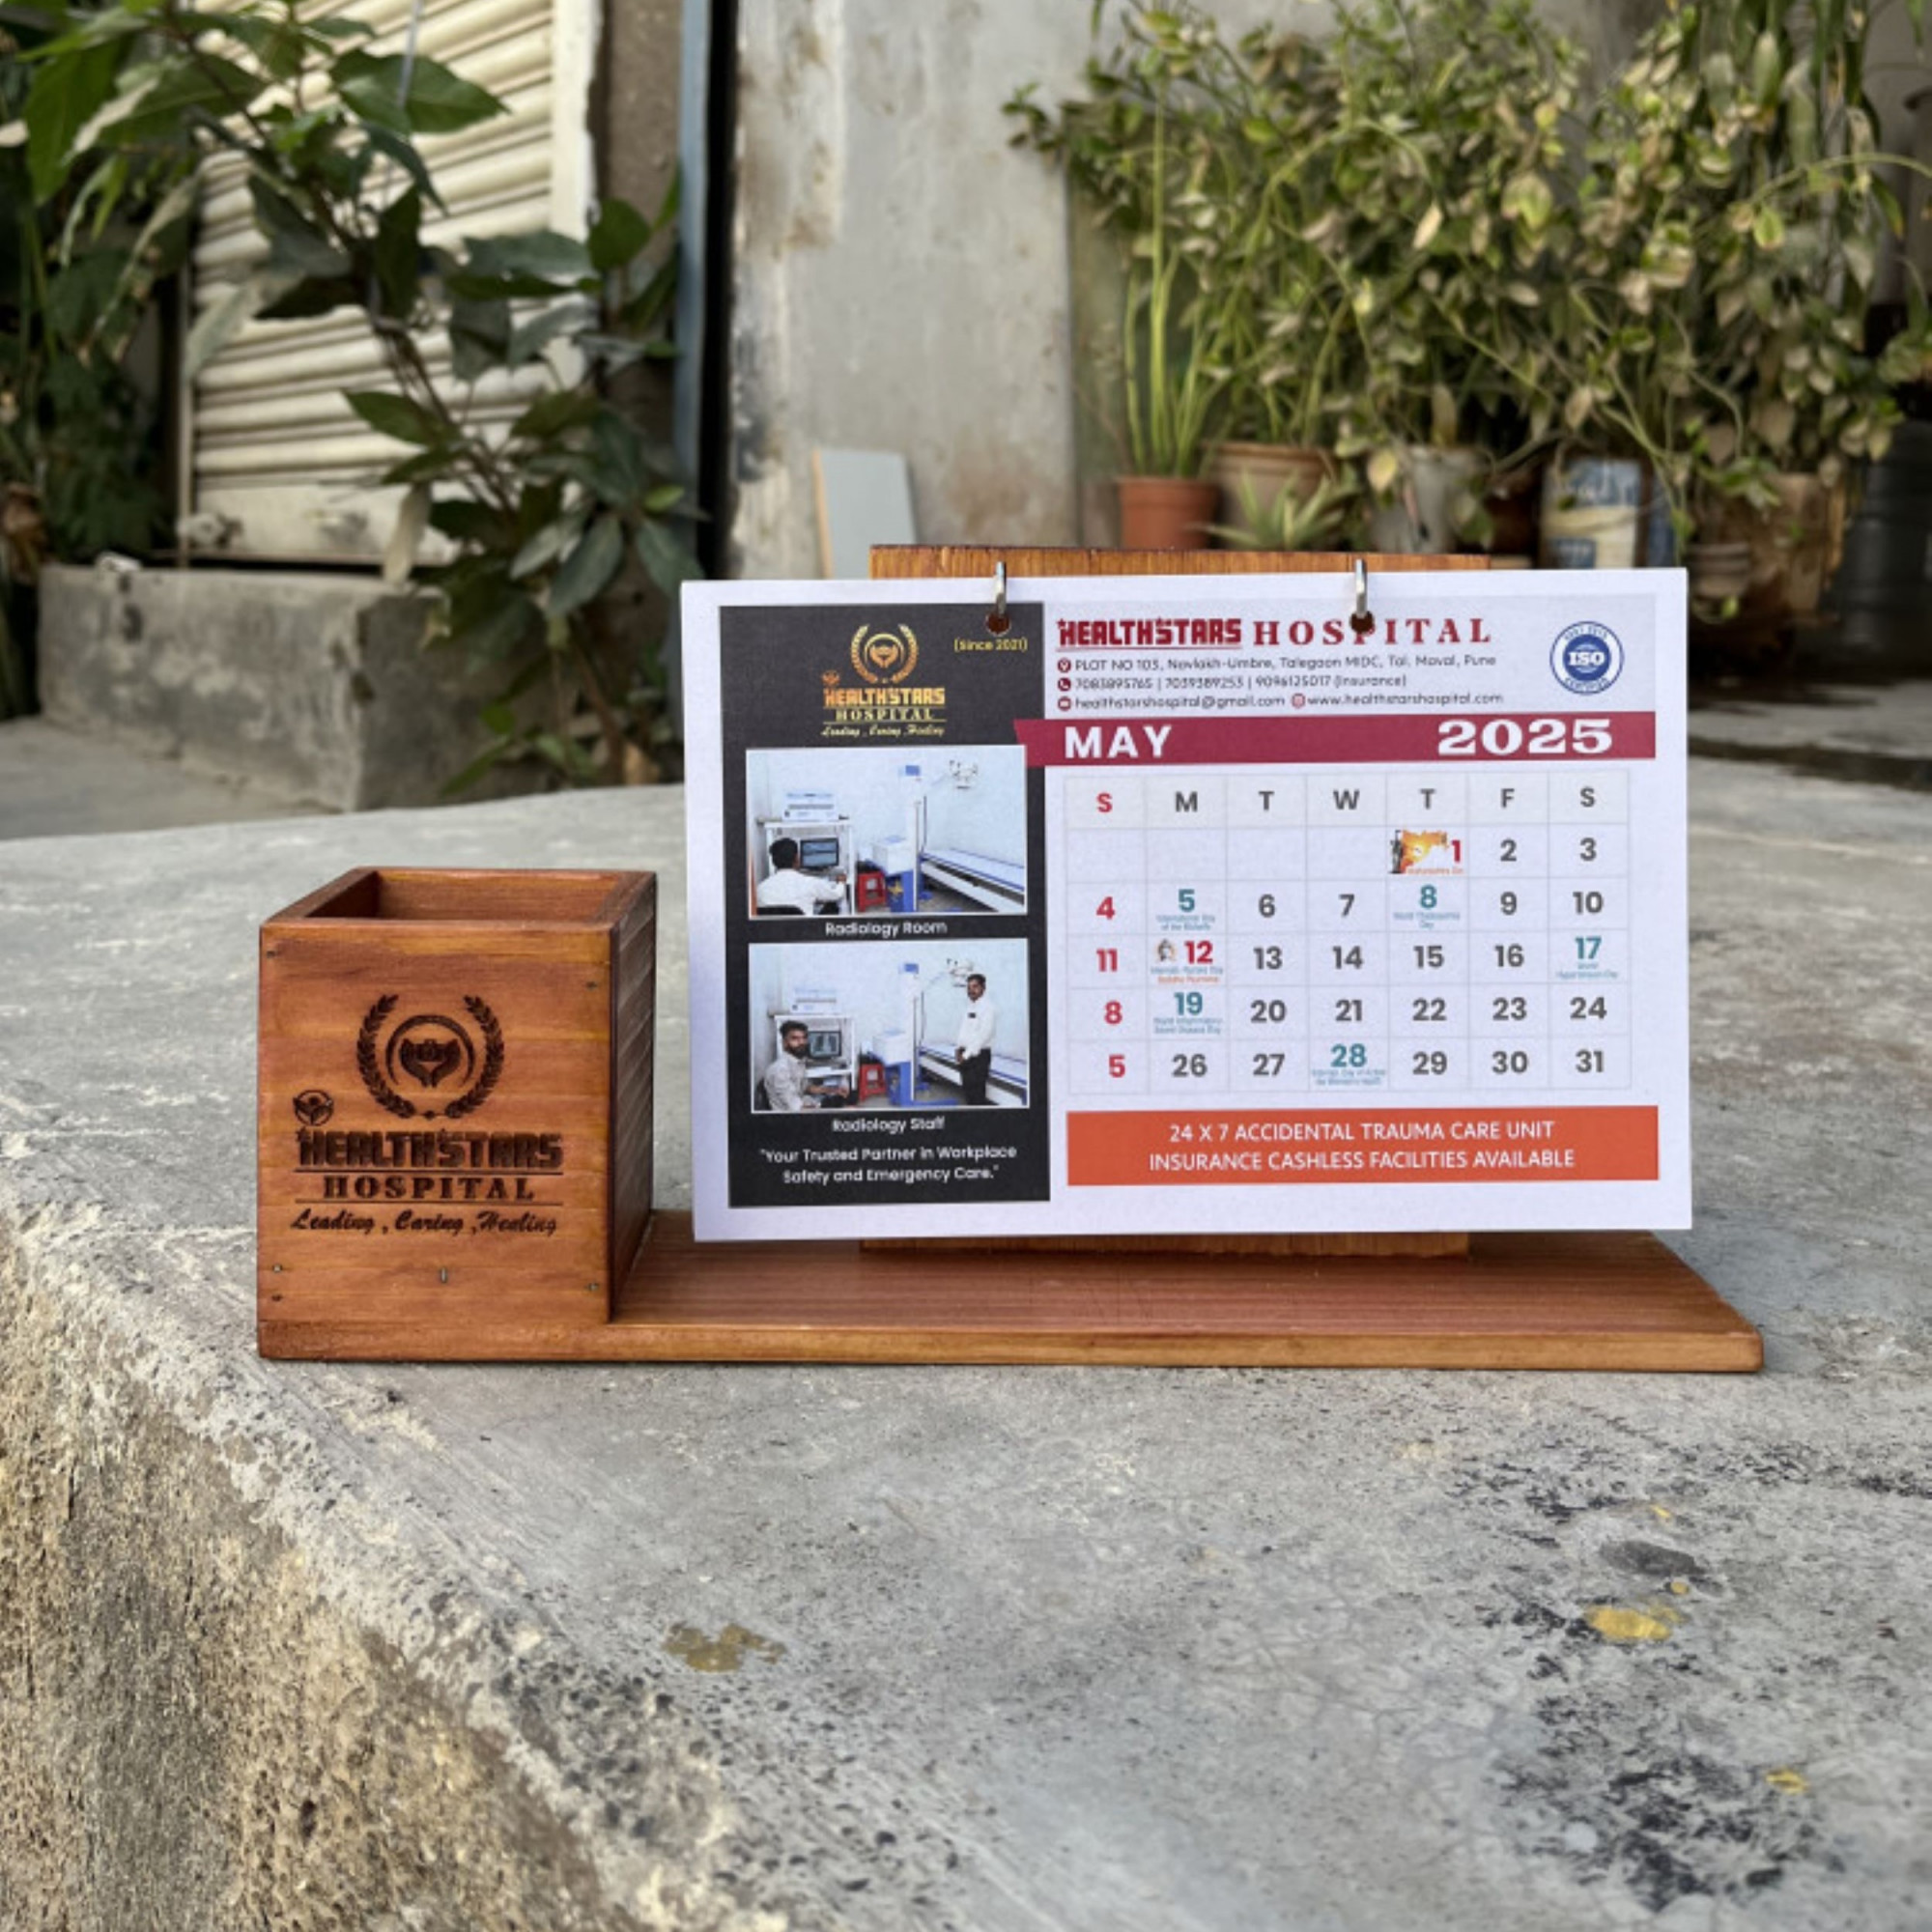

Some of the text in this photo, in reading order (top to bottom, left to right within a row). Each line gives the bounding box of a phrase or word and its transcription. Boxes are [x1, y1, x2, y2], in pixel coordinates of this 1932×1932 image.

[1057, 618, 1241, 646] HEALTHSTARS
[1075, 660, 1107, 670] PLOT
[1112, 660, 1133, 670] NO
[1464, 654, 1495, 666] Pune
[1569, 652, 1605, 666] ISO
[824, 688, 945, 706] HEALTHSTARS
[836, 709, 934, 722] HOSPITAL
[1065, 719, 1612, 758] MAY 2025
[1097, 786, 1595, 812] S M T W T F S
[1451, 838, 1597, 862] 1 2 3
[1096, 885, 1604, 920] 4 5 6 7 8 9 10
[826, 922, 947, 938] Radiology Room
[1096, 936, 1602, 972] 11 12 13 14 15 16 17
[1175, 992, 1203, 1015] 19
[1251, 1000, 1287, 1023] 20
[1336, 1000, 1362, 1021] 21
[1413, 998, 1446, 1021] 22
[1492, 997, 1526, 1020] 23
[1571, 997, 1607, 1019] 24
[1173, 1054, 1208, 1077] 26
[1253, 1053, 1285, 1076] 27
[1331, 1043, 1367, 1067] 28
[1413, 1051, 1447, 1075] 29
[1492, 1051, 1528, 1074] 30
[1577, 1049, 1604, 1072] 31
[833, 1116, 945, 1134] Radiology Staff
[1171, 1121, 1554, 1142] 24 X 7 ACCIDENTAL TRAUMA CARE UNIT
[296, 1127, 562, 1170] HEALTHSTARS
[803, 1149, 858, 1161] Trusted
[862, 1149, 916, 1160] Partner
[937, 1146, 1016, 1161] Workplace
[1151, 1150, 1574, 1171] INSURANCE CASHLESS FACILITIES AVAILABLE
[324, 1176, 534, 1200] HOSPITAL
[783, 1170, 830, 1185] Safety
[834, 1170, 863, 1181] and
[867, 1170, 951, 1183] Emergency
